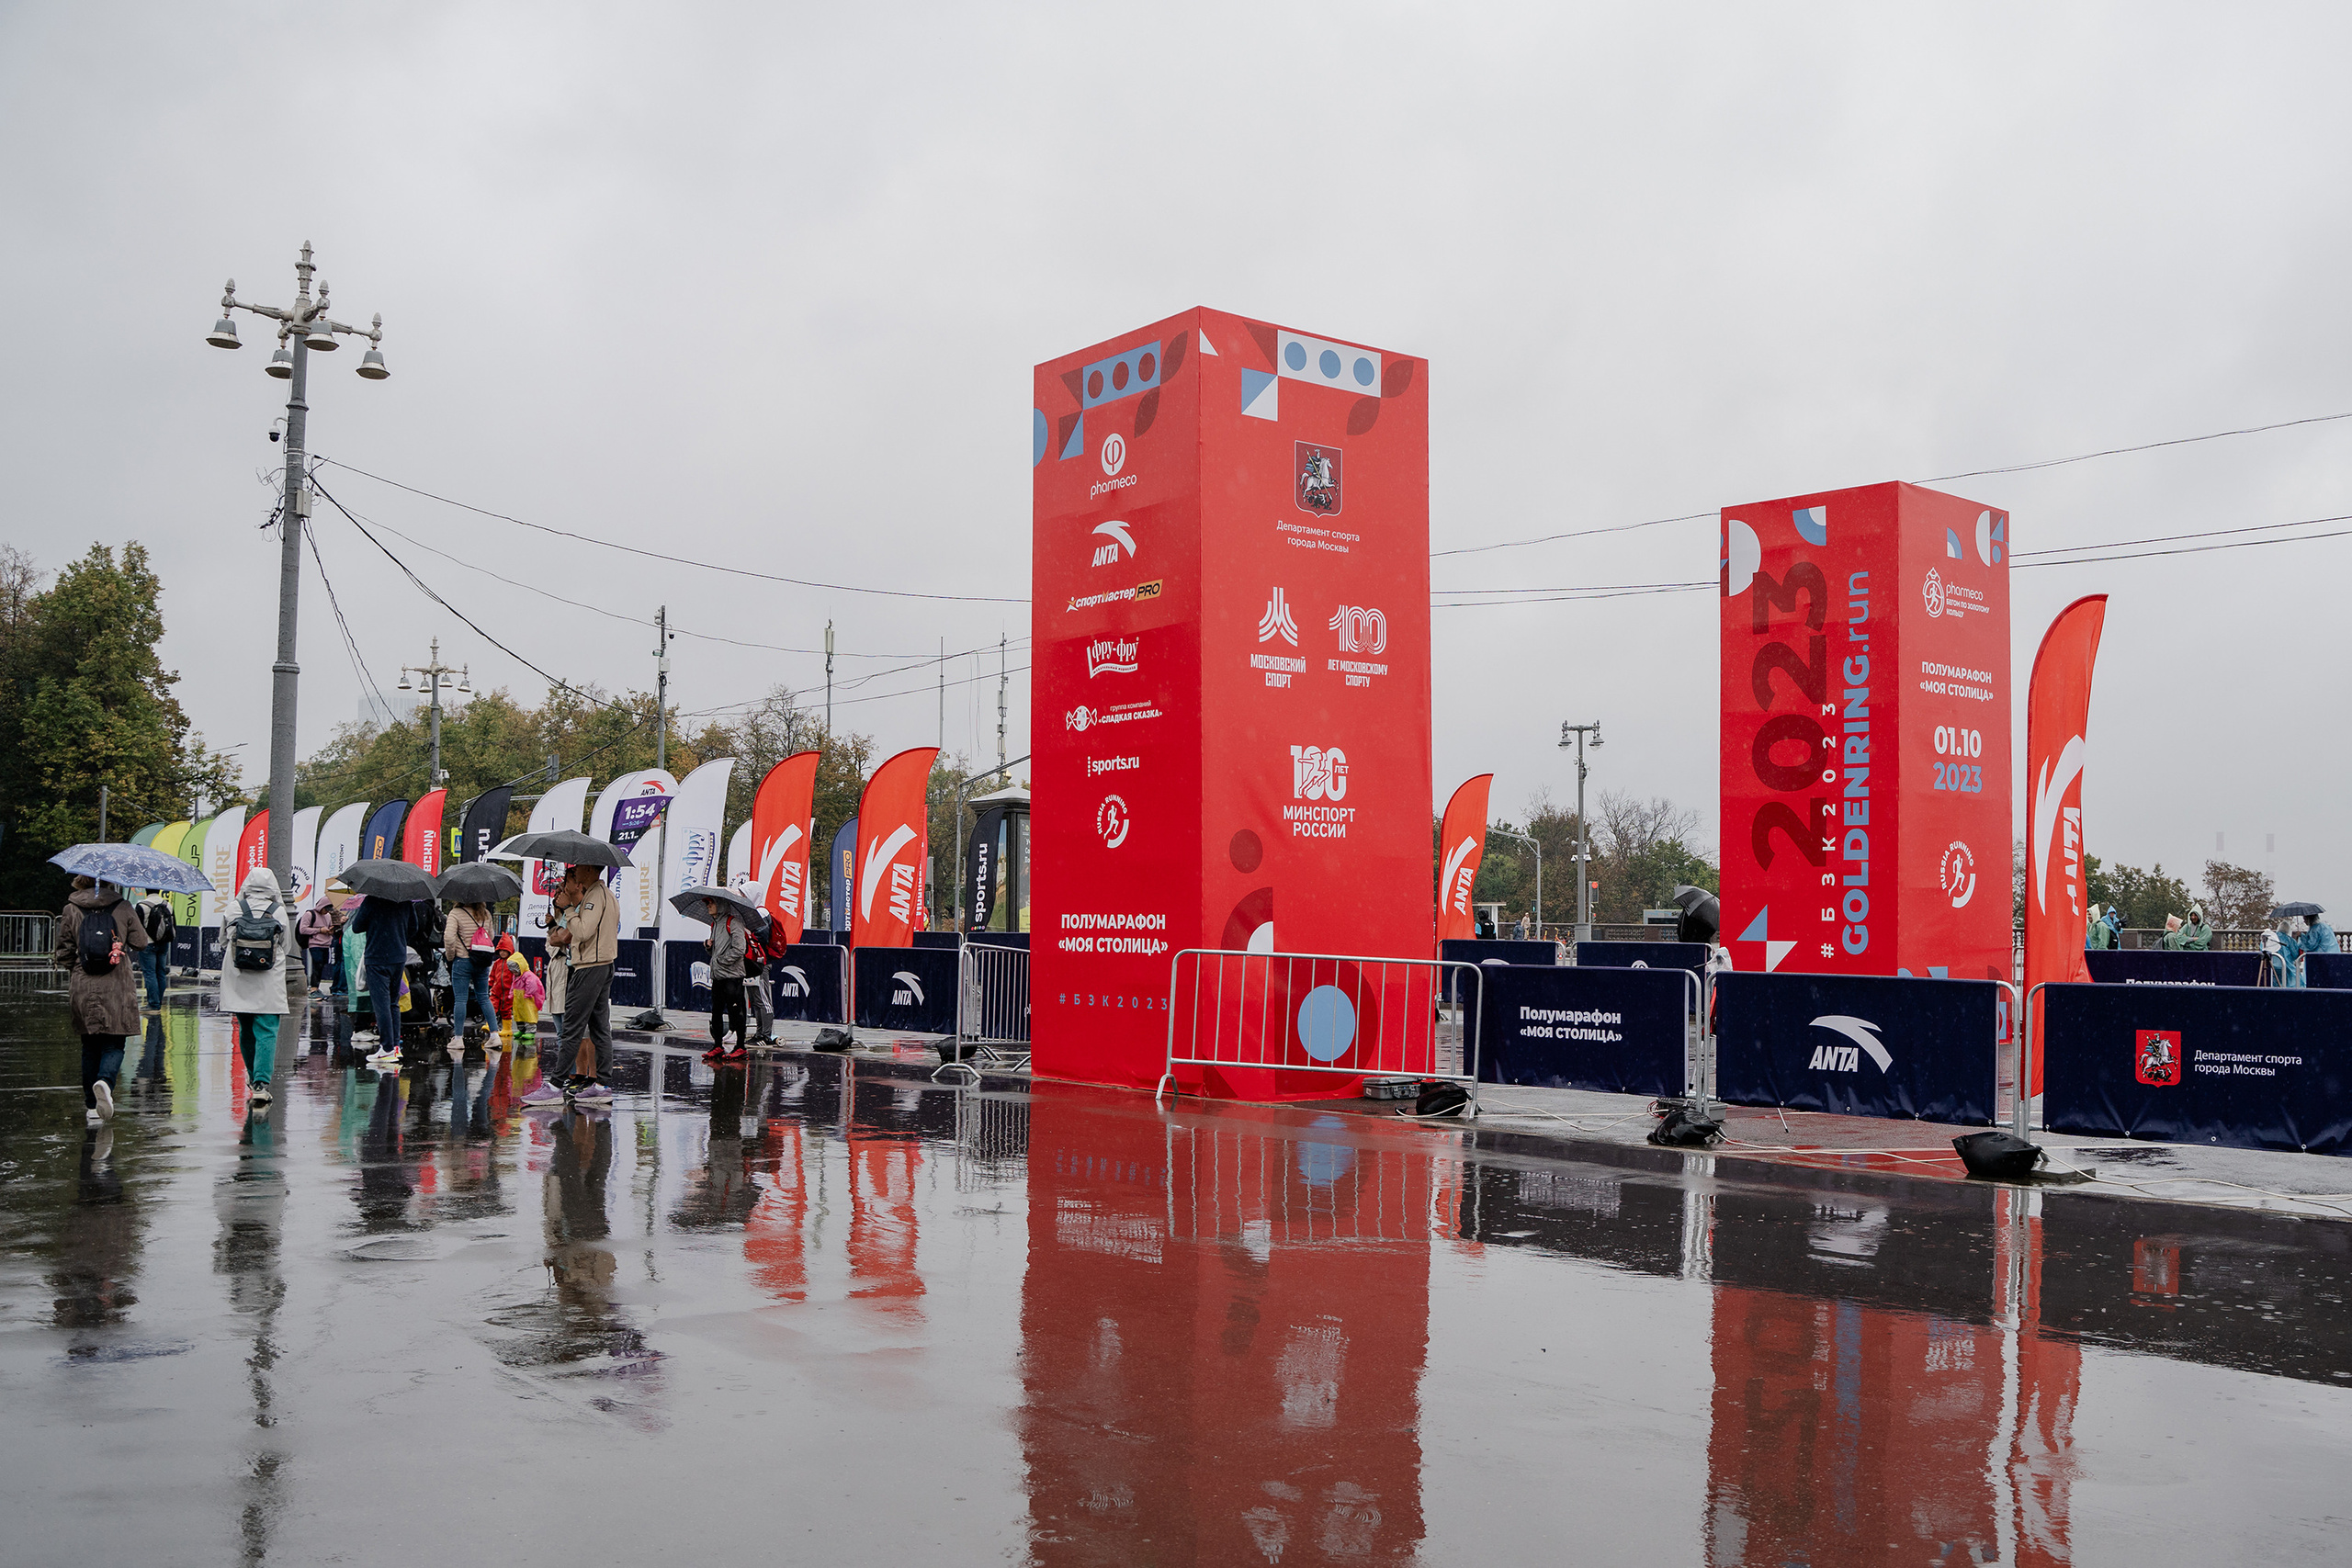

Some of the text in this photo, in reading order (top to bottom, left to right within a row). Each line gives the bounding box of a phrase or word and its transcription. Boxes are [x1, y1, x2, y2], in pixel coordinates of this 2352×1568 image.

[1090, 474, 1137, 500] pharmeco
[1276, 520, 1360, 542] Департамент спорта
[1287, 537, 1349, 553] города Москвы
[1091, 543, 1118, 568] ANTA
[1136, 582, 1160, 598] PRO
[1946, 581, 1983, 601] pharmeco
[1329, 604, 1387, 655] 100
[1250, 653, 1306, 673] МОСКОВСКИЙ
[1328, 659, 1388, 675] ЛЕТ МОСКОВСКОМУ
[1921, 661, 1992, 683] ПОЛУМАРАФОН
[1265, 671, 1292, 688] СПОРТ
[1345, 674, 1370, 687] СПОРТУ
[1919, 680, 1994, 702] «МОЯ СТОЛИЦА»
[1751, 561, 1828, 872] 2023
[1934, 725, 1982, 758] 01.10
[1091, 755, 1139, 775] sports.ru
[1334, 765, 1349, 774] ЛЕТ
[1842, 570, 1870, 954] GOLDENRING.run
[1933, 761, 1983, 793] 2023
[625, 803, 656, 820] 1:54
[1096, 794, 1128, 834] RUSSIA RUNNING
[1283, 805, 1355, 822] МИНСПОРТ
[1293, 821, 1346, 838] РОССИИ
[375, 839, 383, 860] RO
[1939, 840, 1974, 890] RUSSIA RUNNING
[186, 844, 200, 926] POWUP
[779, 861, 801, 918] ANTA
[975, 843, 989, 923] sports.ru
[1453, 867, 1474, 916] ANTA
[889, 863, 915, 925] ANTA
[1061, 913, 1166, 930] ПОЛУМАРАФОН
[1058, 937, 1168, 956] «МОЯ СТОЛИЦА»
[782, 982, 799, 998] ANTA
[891, 989, 912, 1006] ANTA
[1520, 1006, 1622, 1026] Полумарафон
[1520, 1025, 1623, 1043] «МОЯ СТОЛИЦА»
[1808, 1045, 1859, 1072] ANTA
[2194, 1049, 2302, 1066] Департамент спорта
[2194, 1064, 2276, 1077] города Москвы
